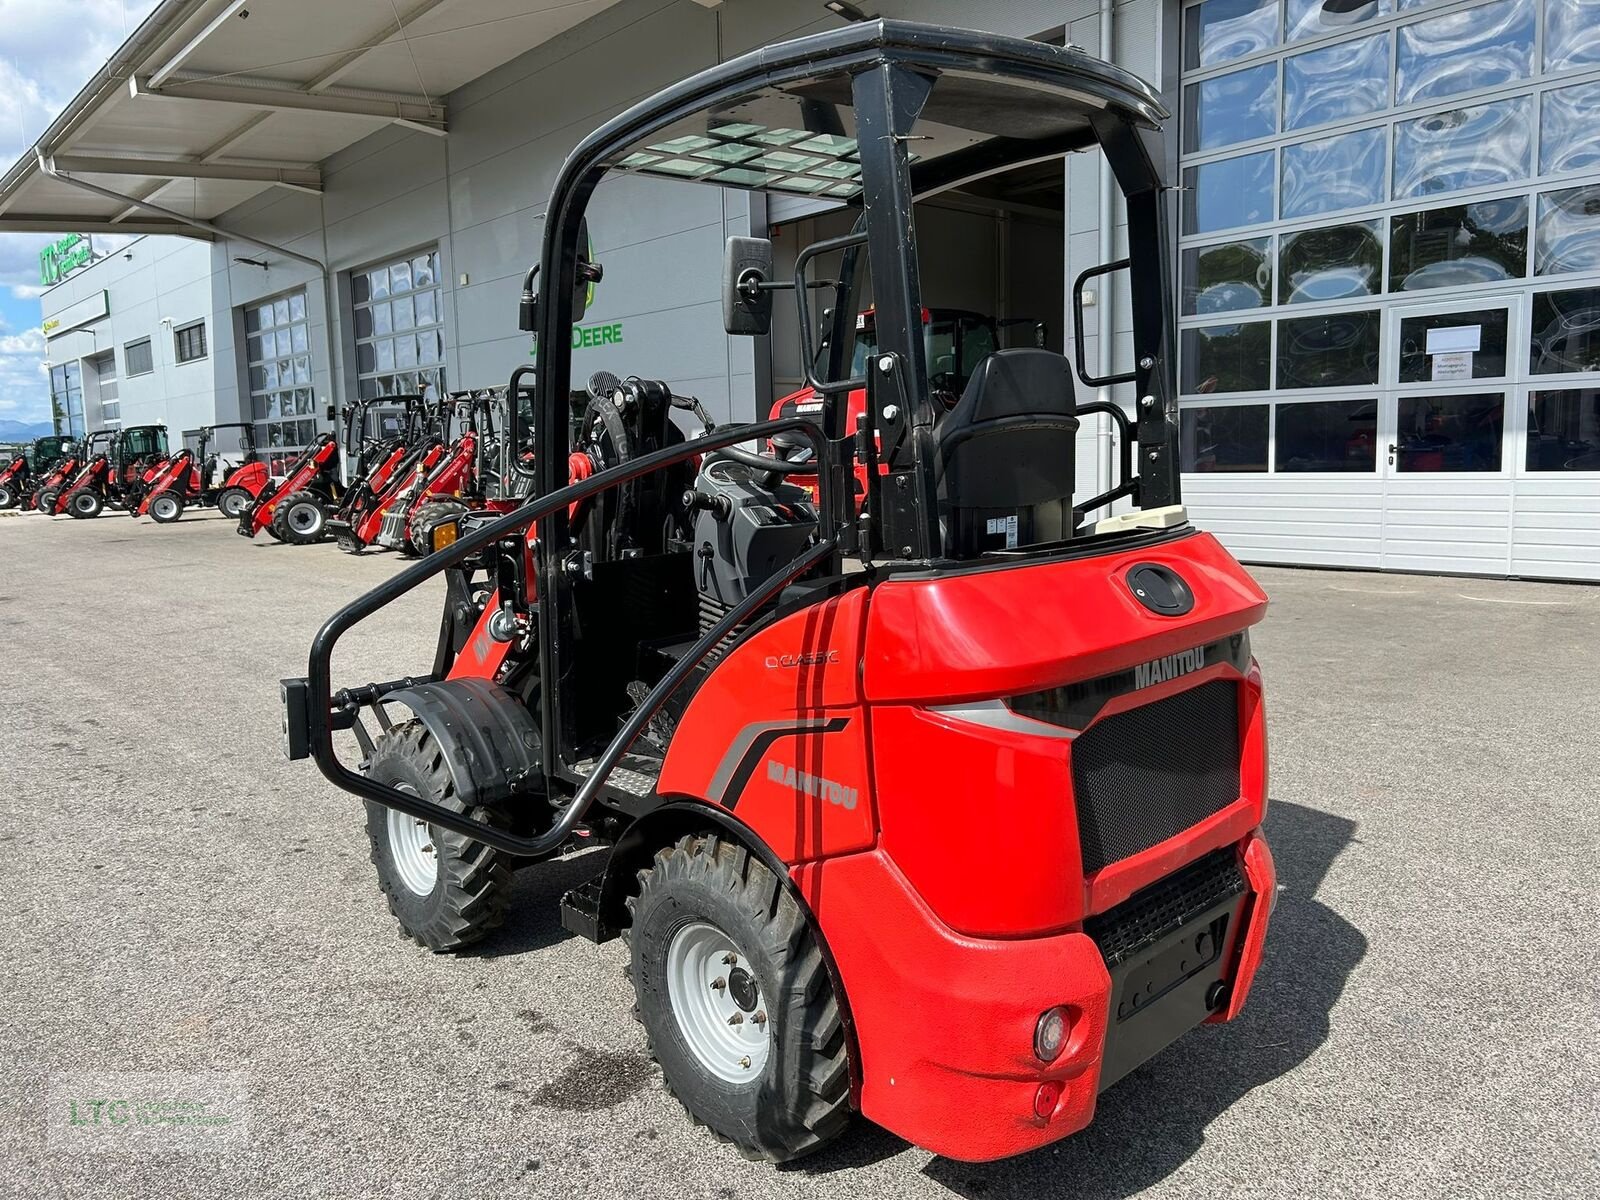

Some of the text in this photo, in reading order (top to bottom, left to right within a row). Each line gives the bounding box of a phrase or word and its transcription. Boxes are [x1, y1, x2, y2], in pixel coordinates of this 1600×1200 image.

[572, 324, 623, 350] DEERE
[1135, 646, 1205, 690] MANITOU
[767, 760, 858, 810] MANITOU
